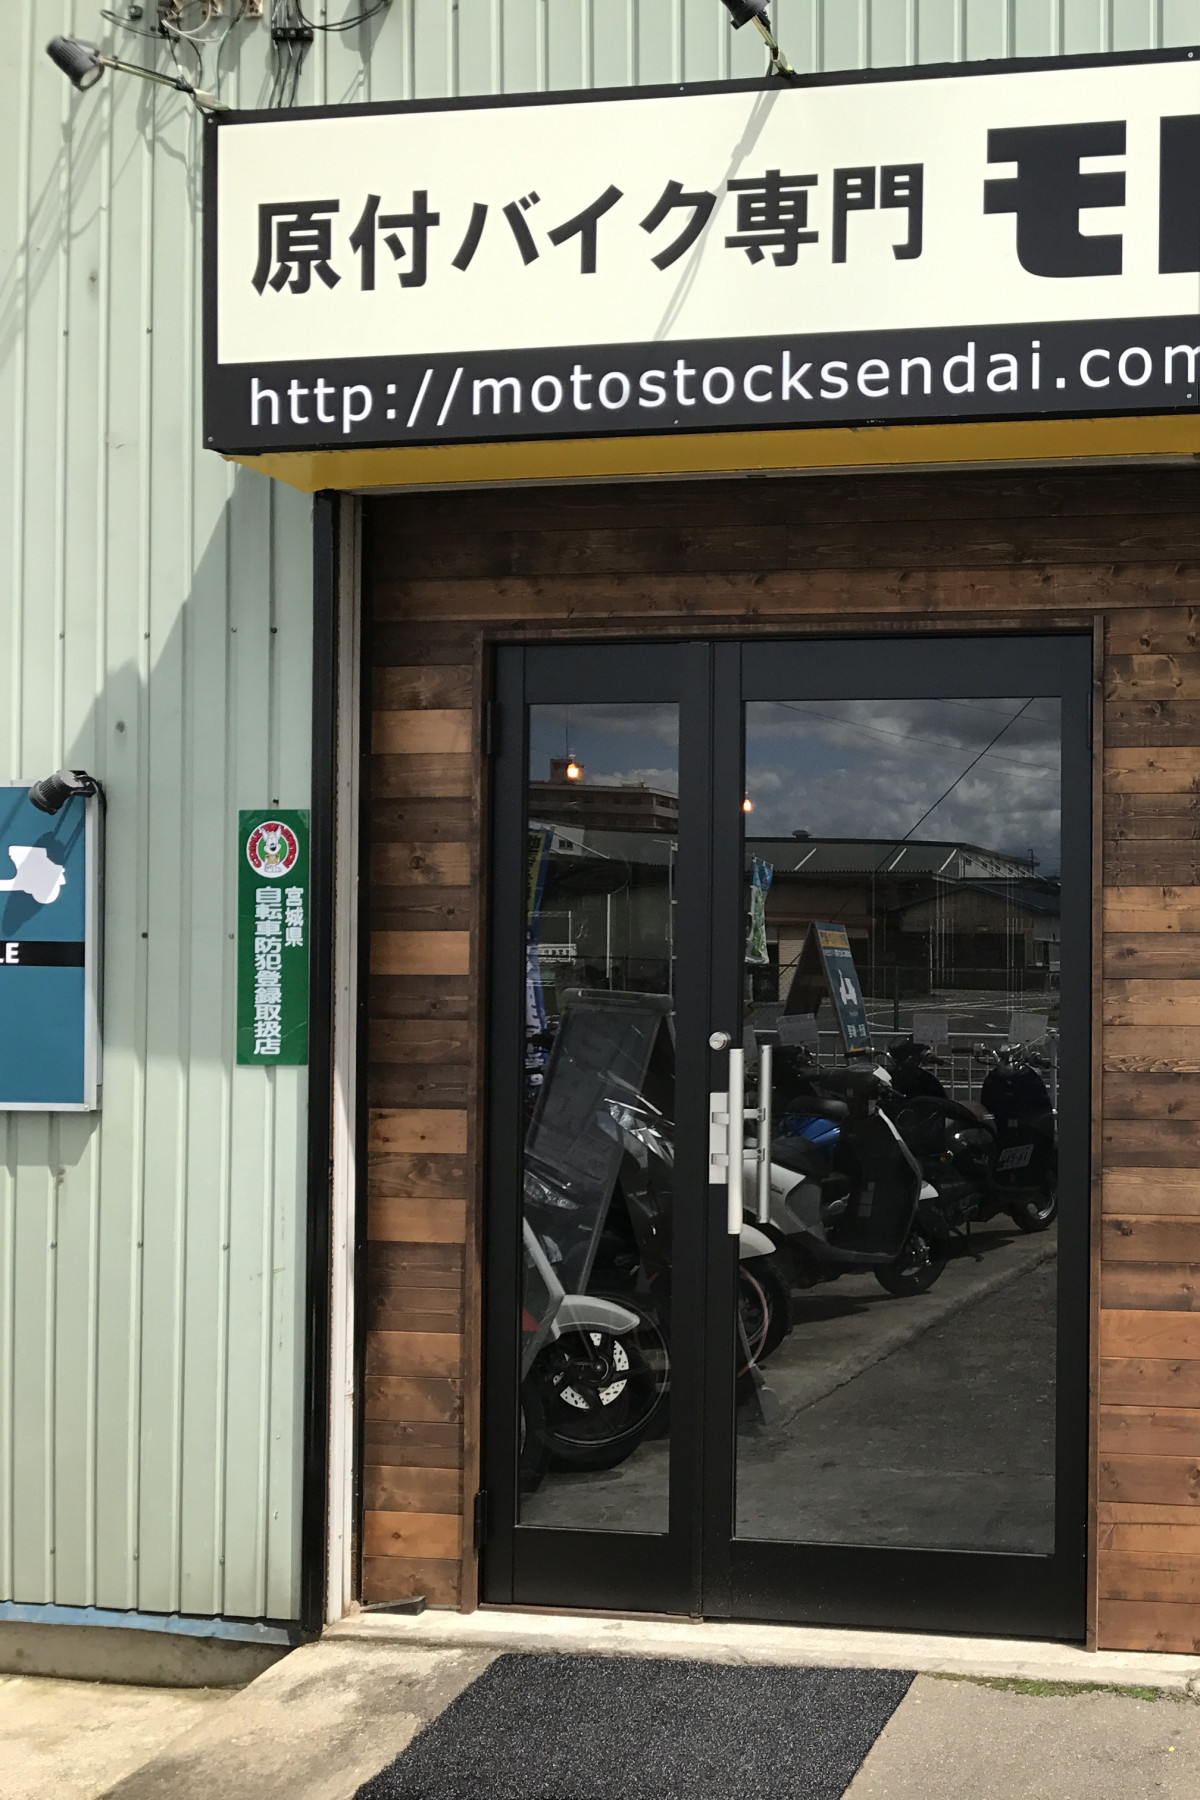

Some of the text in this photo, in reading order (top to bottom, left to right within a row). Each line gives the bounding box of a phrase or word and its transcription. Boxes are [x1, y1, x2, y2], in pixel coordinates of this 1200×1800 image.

[250, 162, 925, 296] 原付バイク専門
[0, 942, 20, 964] E
[284, 886, 304, 947] 宮城県
[254, 886, 282, 1055] 自転車防犯登録取扱店
